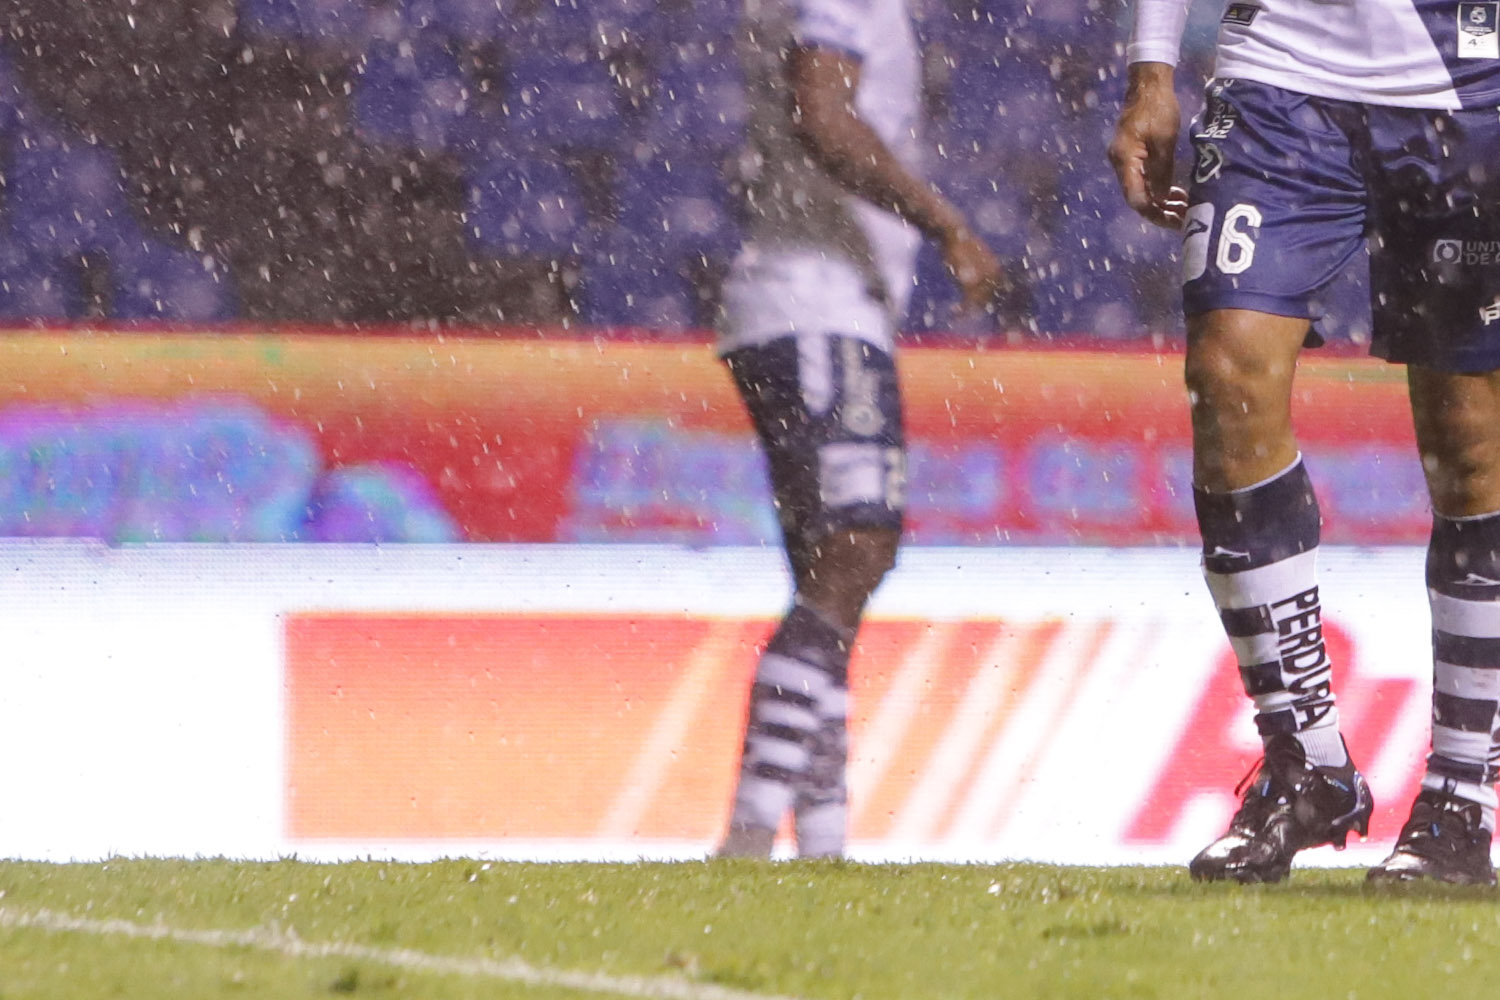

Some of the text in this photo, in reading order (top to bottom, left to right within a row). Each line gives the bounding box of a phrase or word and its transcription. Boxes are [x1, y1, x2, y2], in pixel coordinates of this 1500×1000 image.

[1216, 204, 1262, 274] 6
[1466, 252, 1491, 266] DE
[1270, 584, 1336, 732] PERDURA
